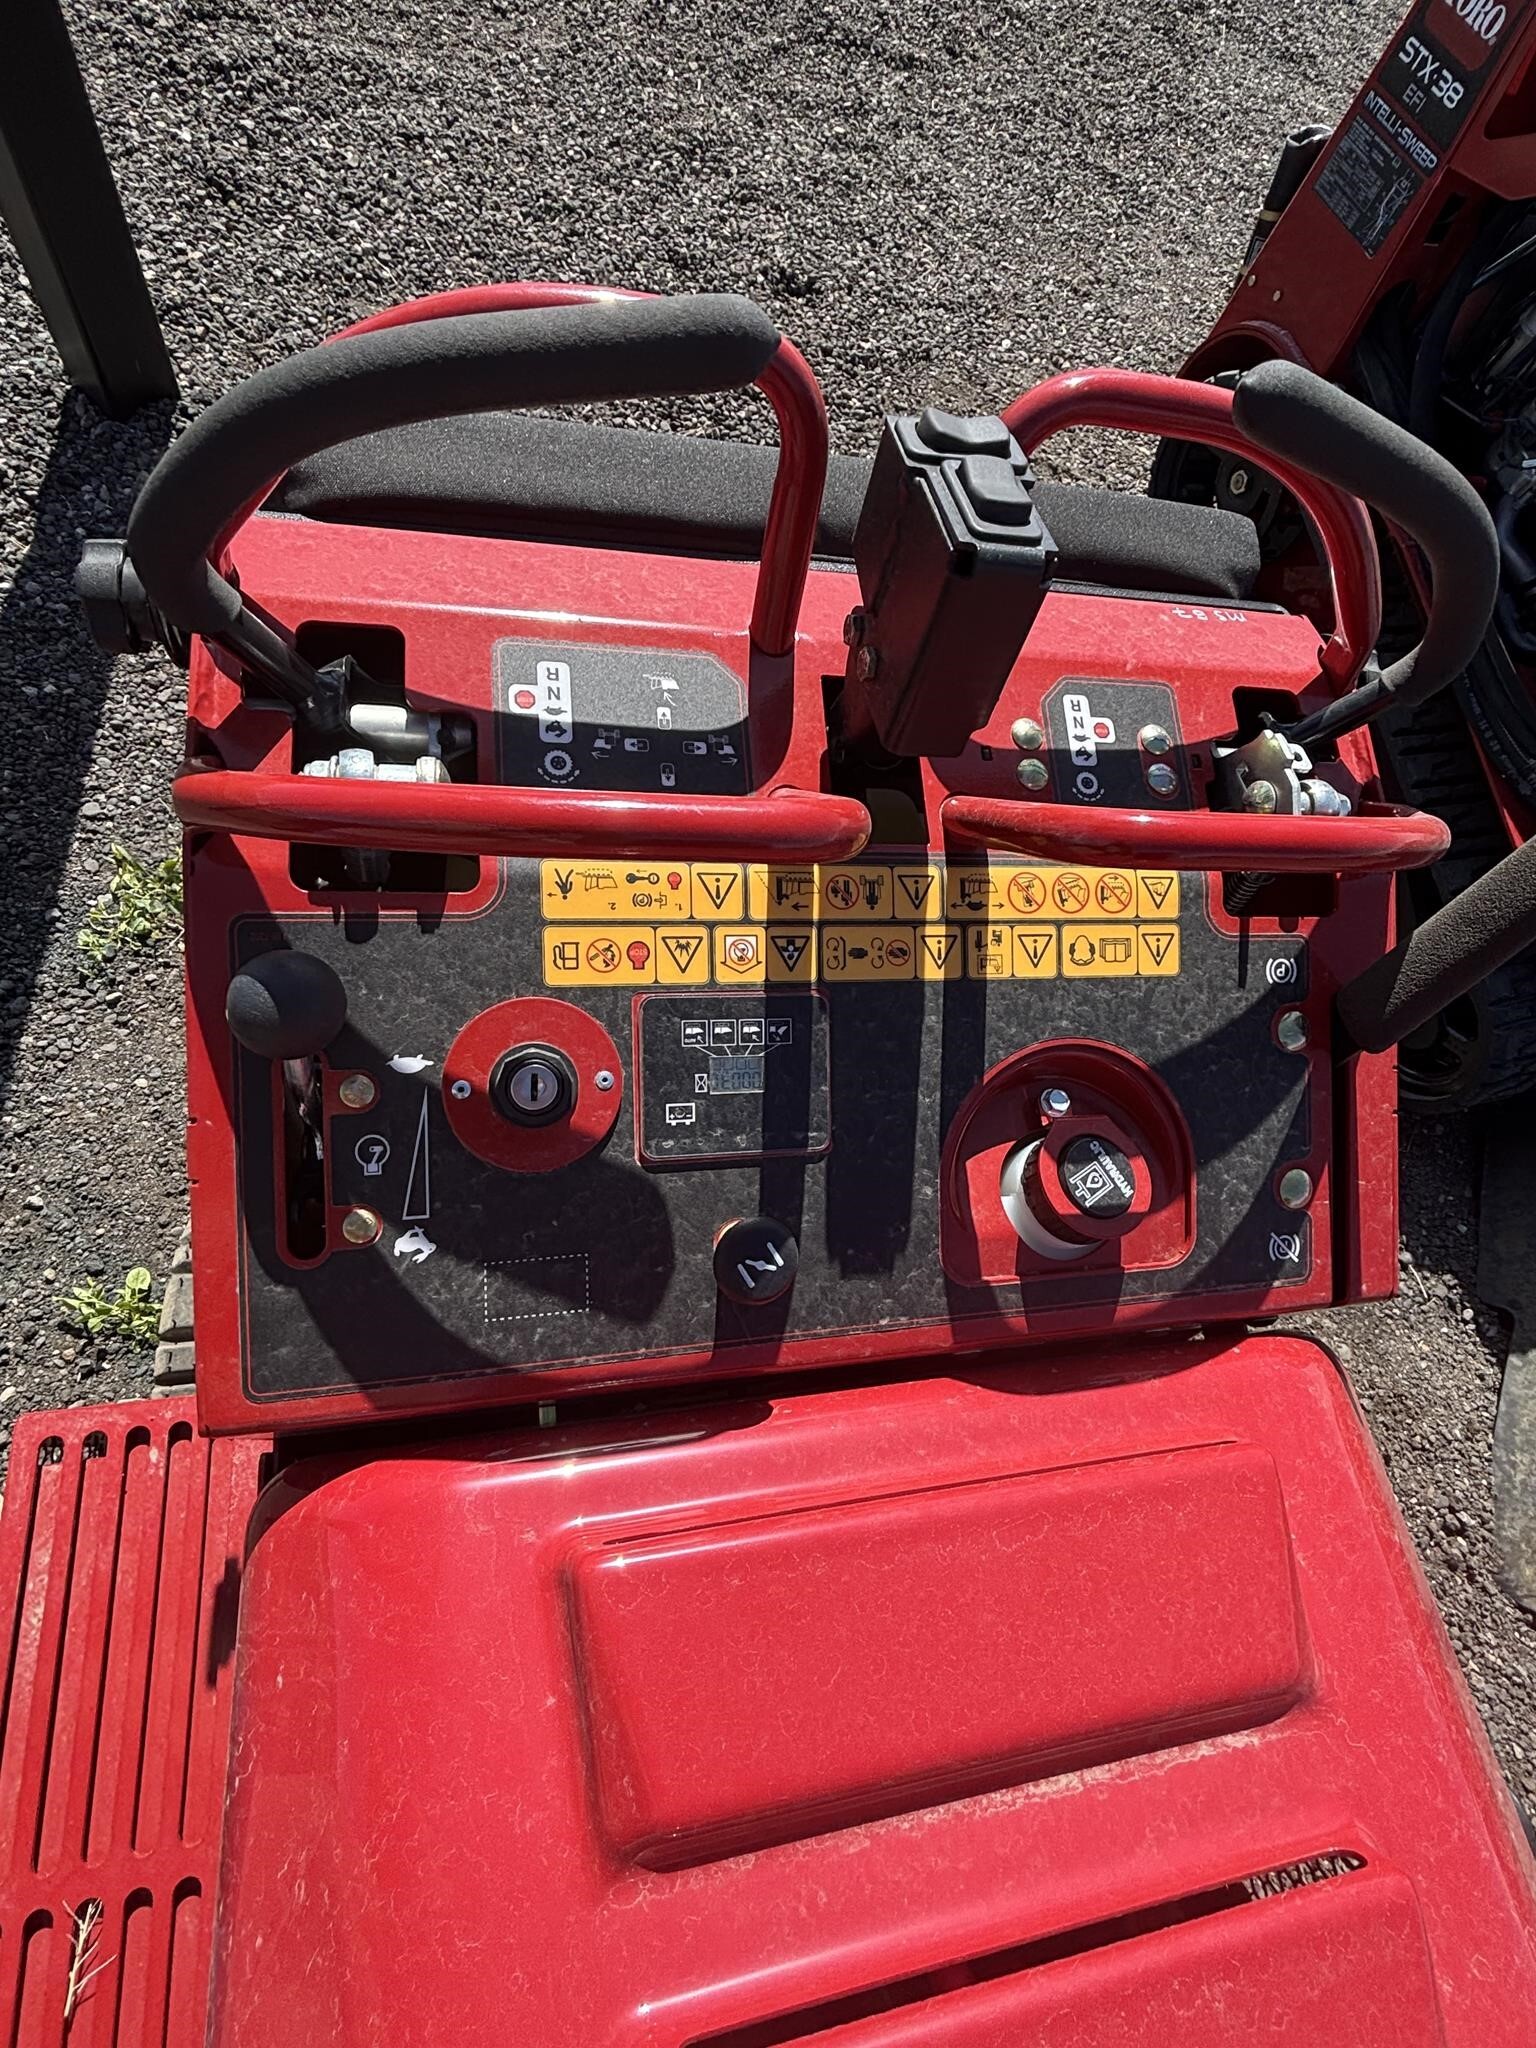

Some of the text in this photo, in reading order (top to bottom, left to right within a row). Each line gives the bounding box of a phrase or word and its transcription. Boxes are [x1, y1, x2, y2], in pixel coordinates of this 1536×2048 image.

[1442, 0, 1507, 41] ORO
[1402, 84, 1427, 114] EFI
[1213, 610, 1247, 622] MS
[546, 668, 559, 681] R
[548, 687, 560, 700] N
[1070, 699, 1081, 712] R
[1073, 716, 1085, 729] N
[1089, 1140, 1135, 1198] HYDRAULIC
